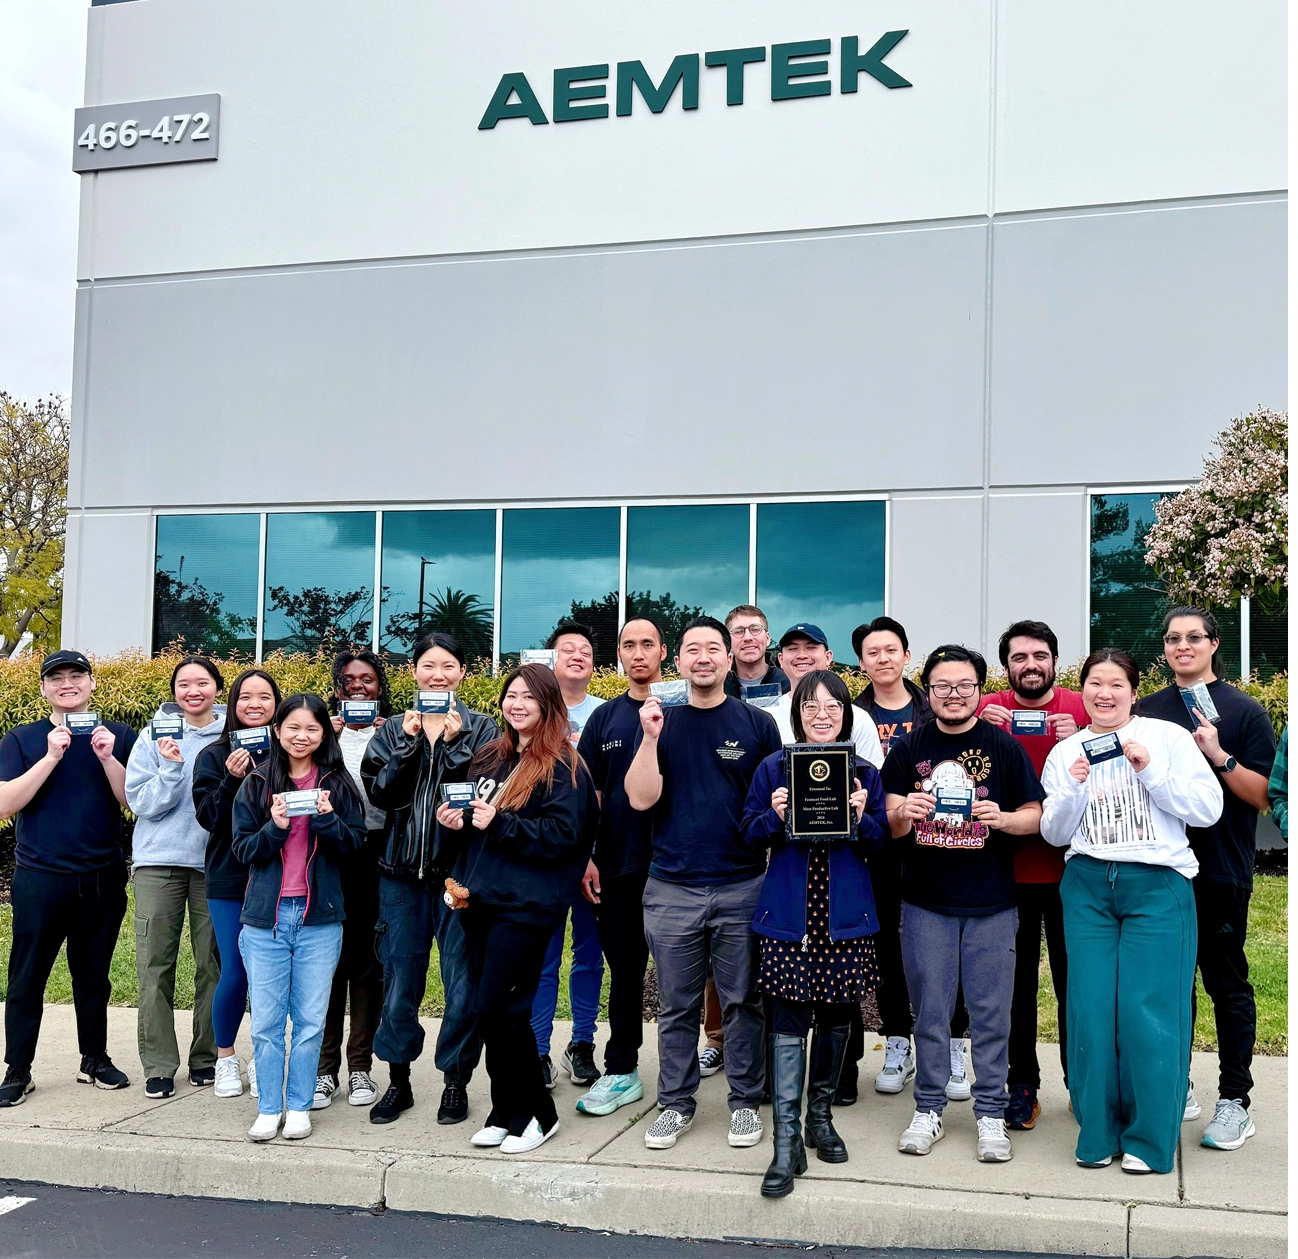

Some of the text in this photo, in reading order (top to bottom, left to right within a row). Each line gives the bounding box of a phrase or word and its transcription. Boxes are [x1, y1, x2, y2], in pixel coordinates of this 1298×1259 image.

[477, 28, 914, 130] AEMTEK
[77, 112, 211, 151] 466-472
[916, 830, 933, 843] Full
[945, 836, 983, 847] Circles
[934, 820, 972, 836] World
